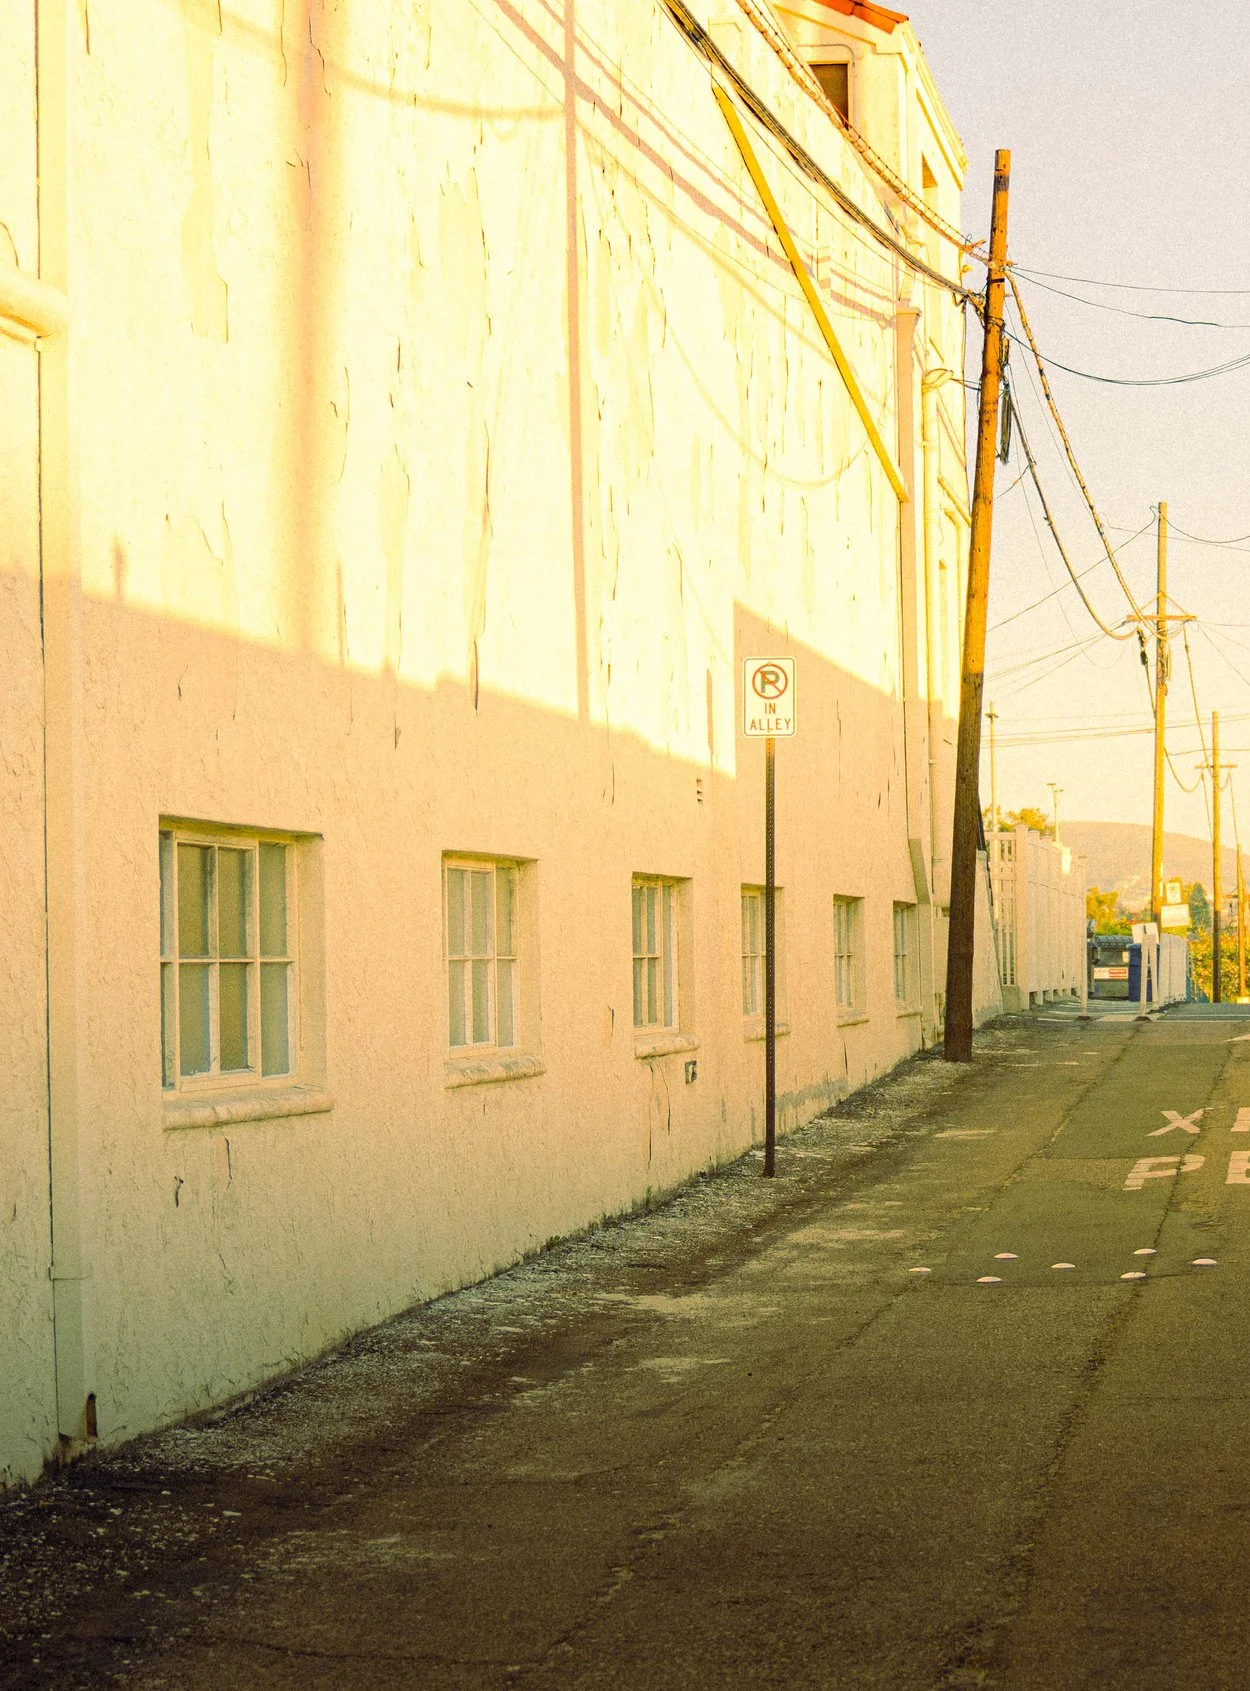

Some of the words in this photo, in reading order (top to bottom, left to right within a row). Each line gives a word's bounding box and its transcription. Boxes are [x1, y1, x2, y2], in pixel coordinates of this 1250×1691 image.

[760, 670, 780, 693] P
[764, 702, 777, 714] IN
[750, 718, 791, 731] ALLEY
